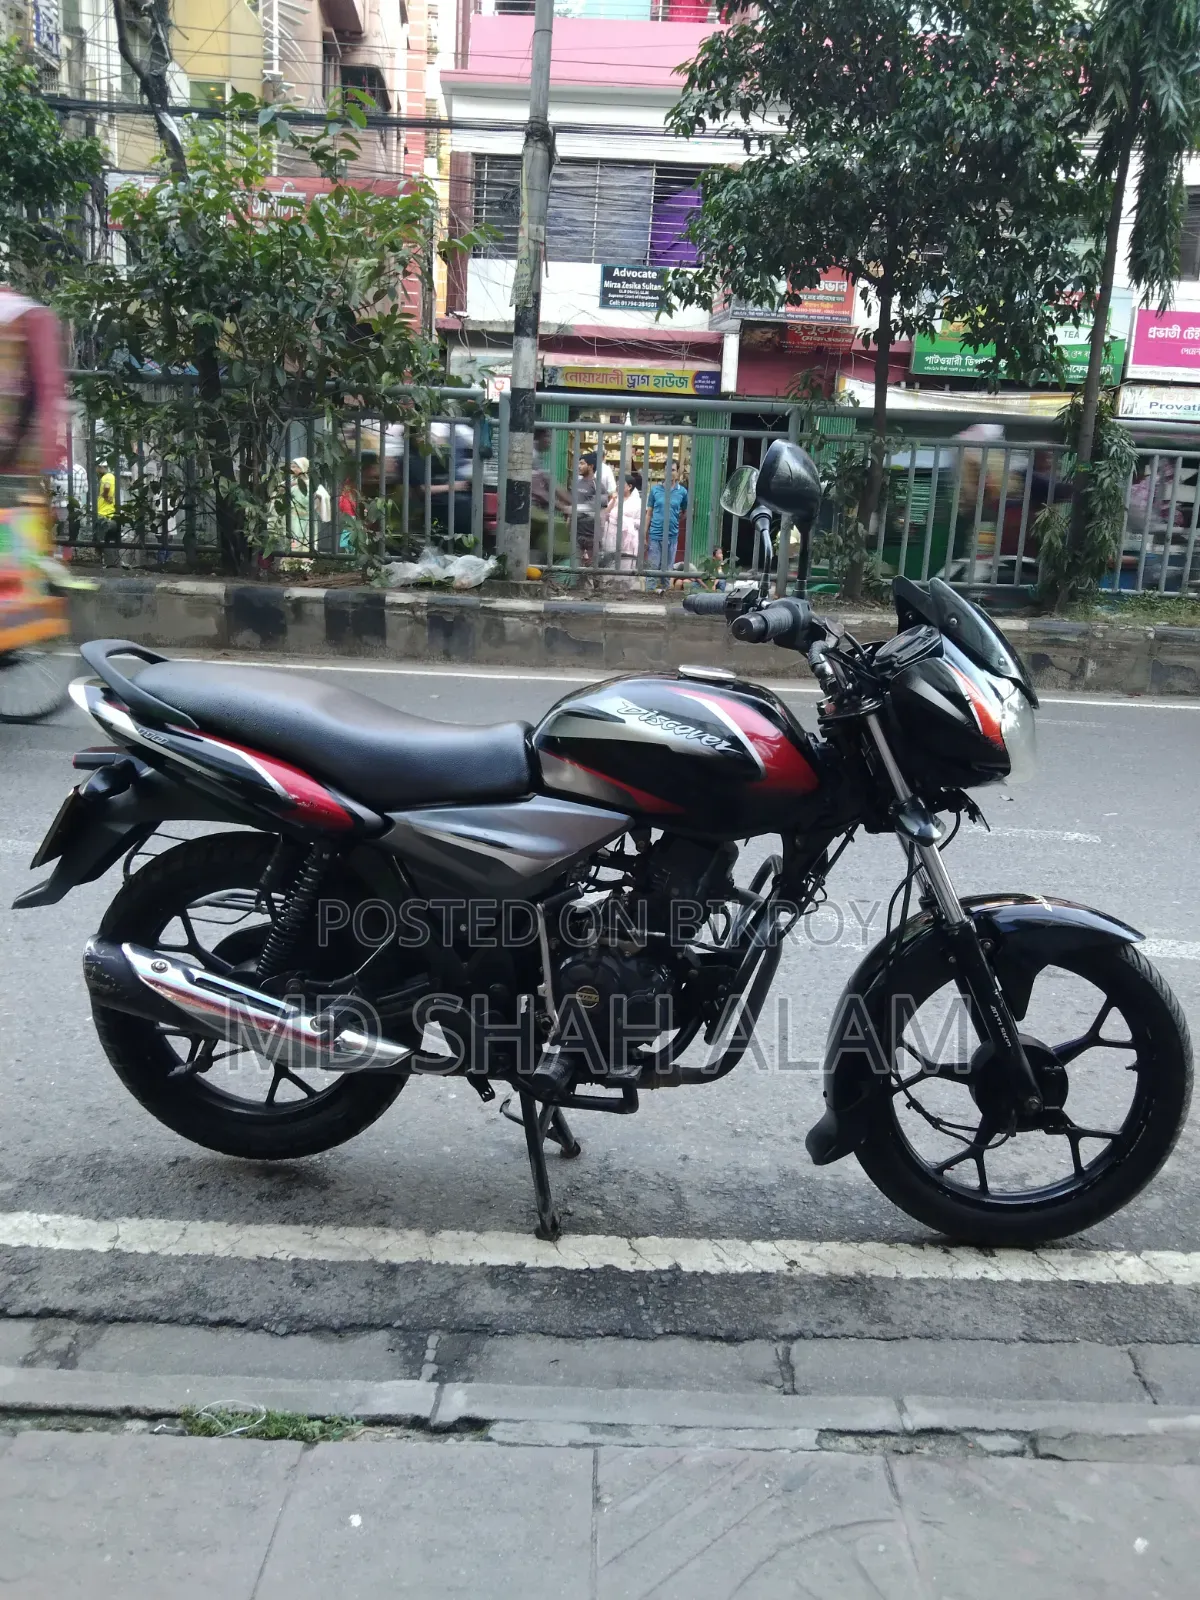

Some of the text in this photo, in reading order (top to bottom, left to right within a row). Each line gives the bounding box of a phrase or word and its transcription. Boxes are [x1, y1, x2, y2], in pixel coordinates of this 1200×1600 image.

[613, 268, 657, 279] Advocate
[604, 281, 620, 289] Mirza
[622, 282, 641, 290] Zesika
[1063, 330, 1080, 339] TEA
[1148, 324, 1181, 339] প্রভাতী
[924, 354, 963, 366] পাটওয়ারী
[565, 370, 689, 390] নোয়াখালী ড্রাগ হাউজ
[617, 701, 743, 754] Discover
